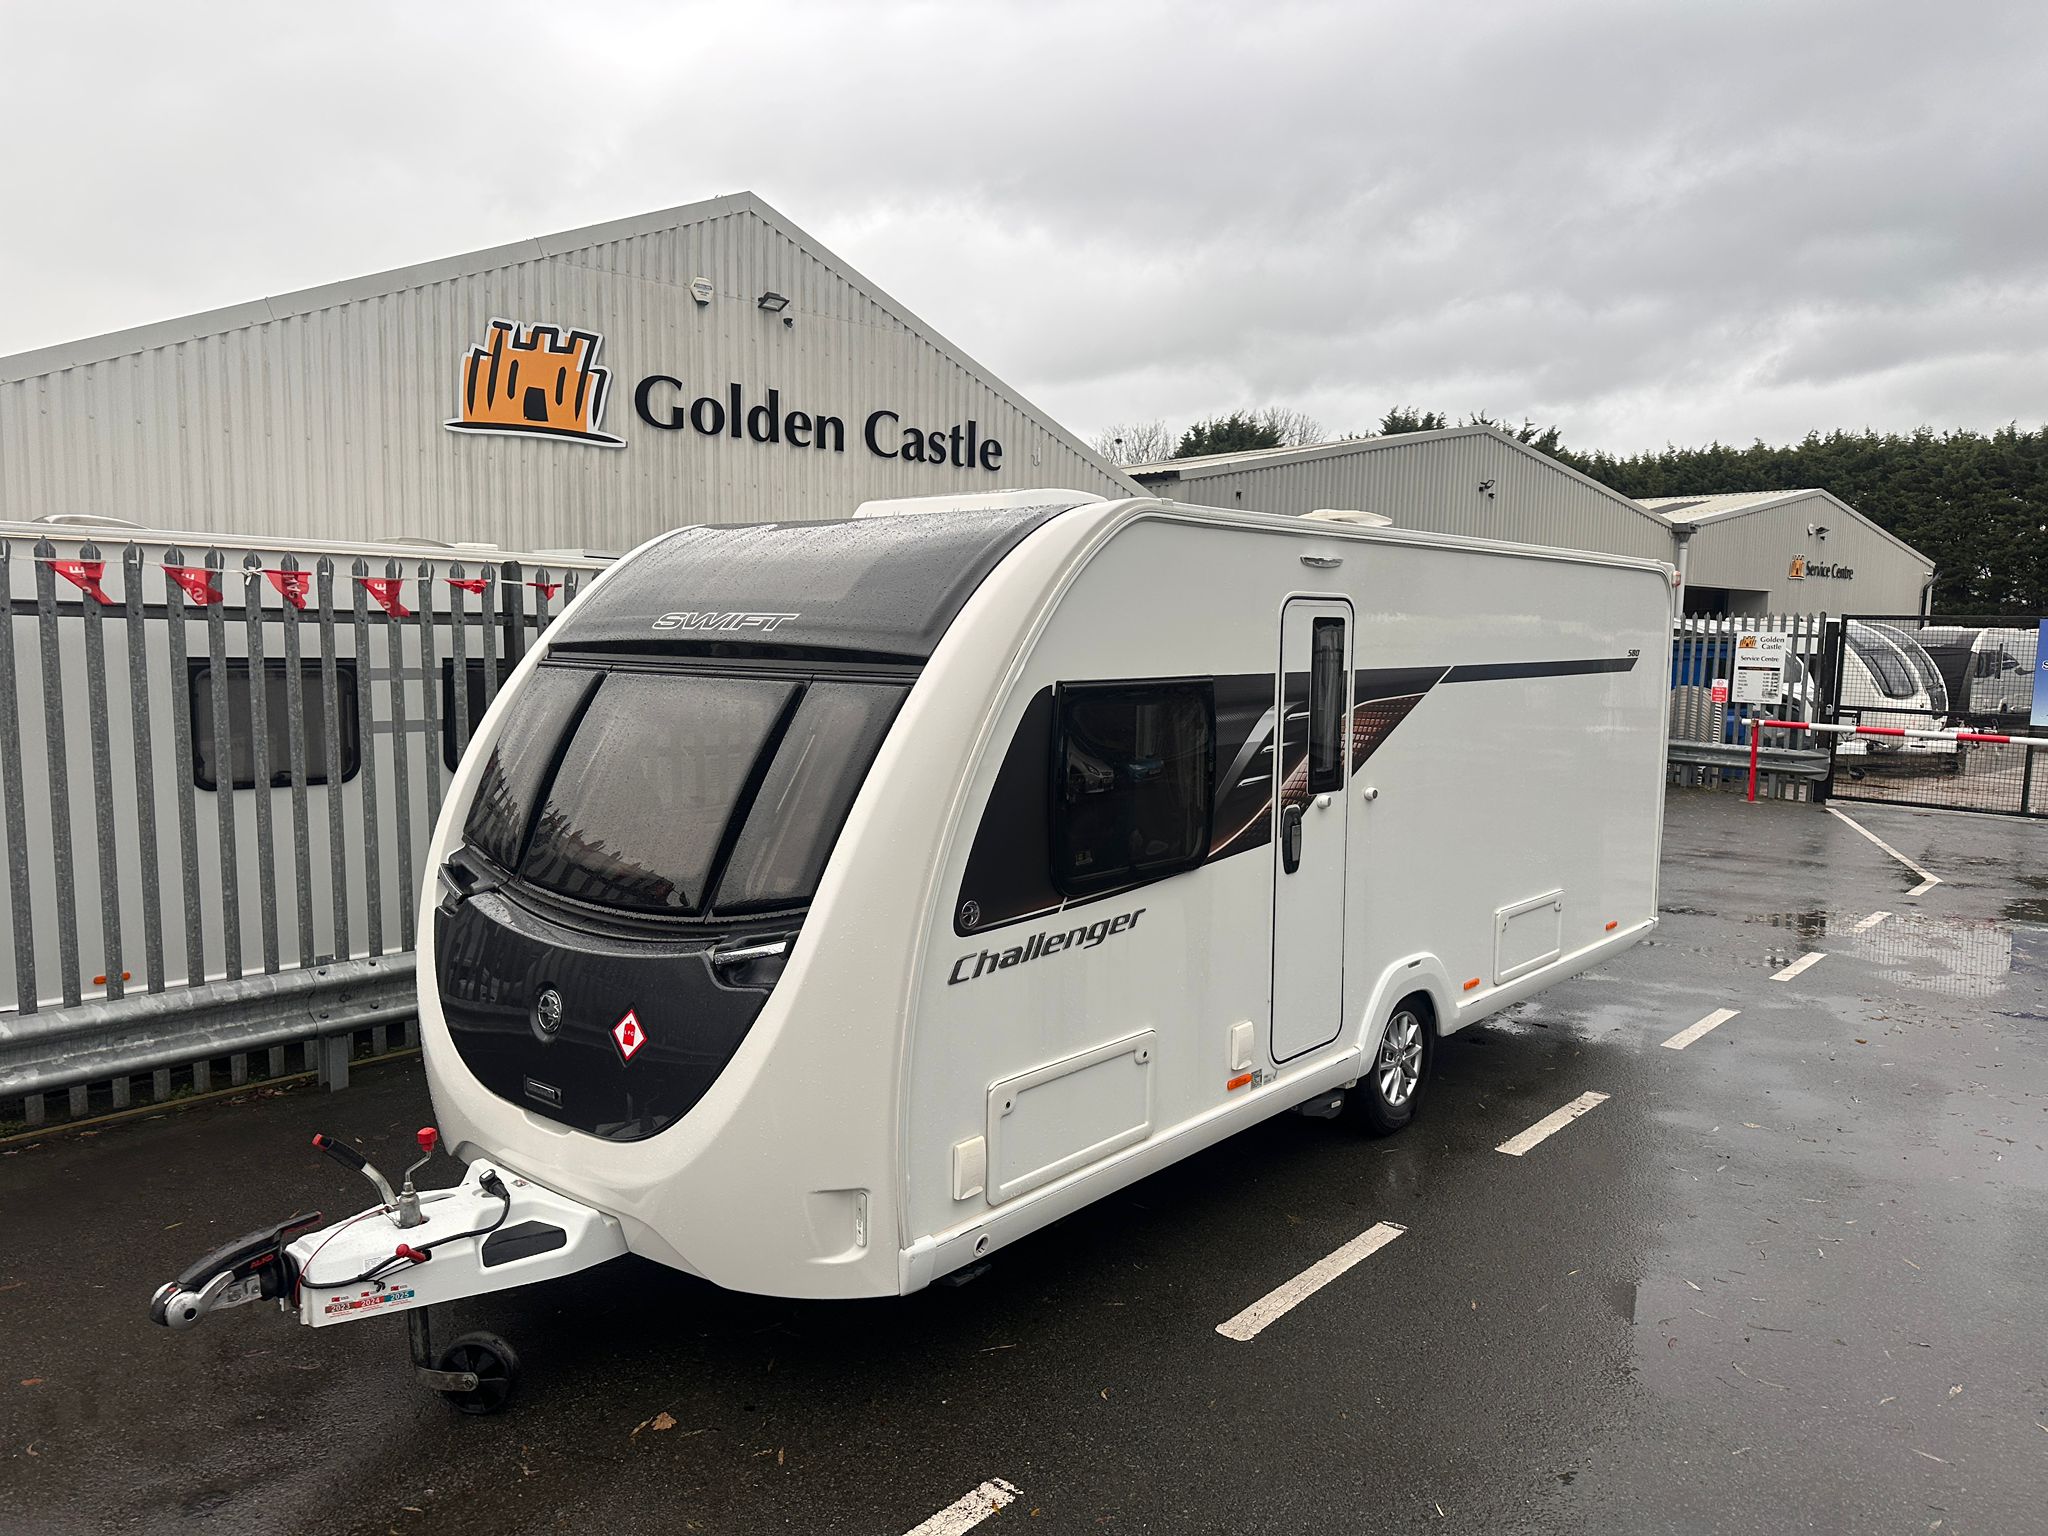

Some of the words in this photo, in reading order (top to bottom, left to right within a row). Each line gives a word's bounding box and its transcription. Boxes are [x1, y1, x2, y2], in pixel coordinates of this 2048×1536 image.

[634, 374, 845, 452] Golden
[864, 409, 1004, 472] Castle
[1806, 561, 1831, 578] Service
[1832, 563, 1854, 580] Centre
[652, 612, 802, 632] SWIFT
[947, 907, 1147, 986] Challenger
[361, 1297, 380, 1306] 2024
[390, 1291, 410, 1301] 2025
[331, 1303, 351, 1312] 2023
